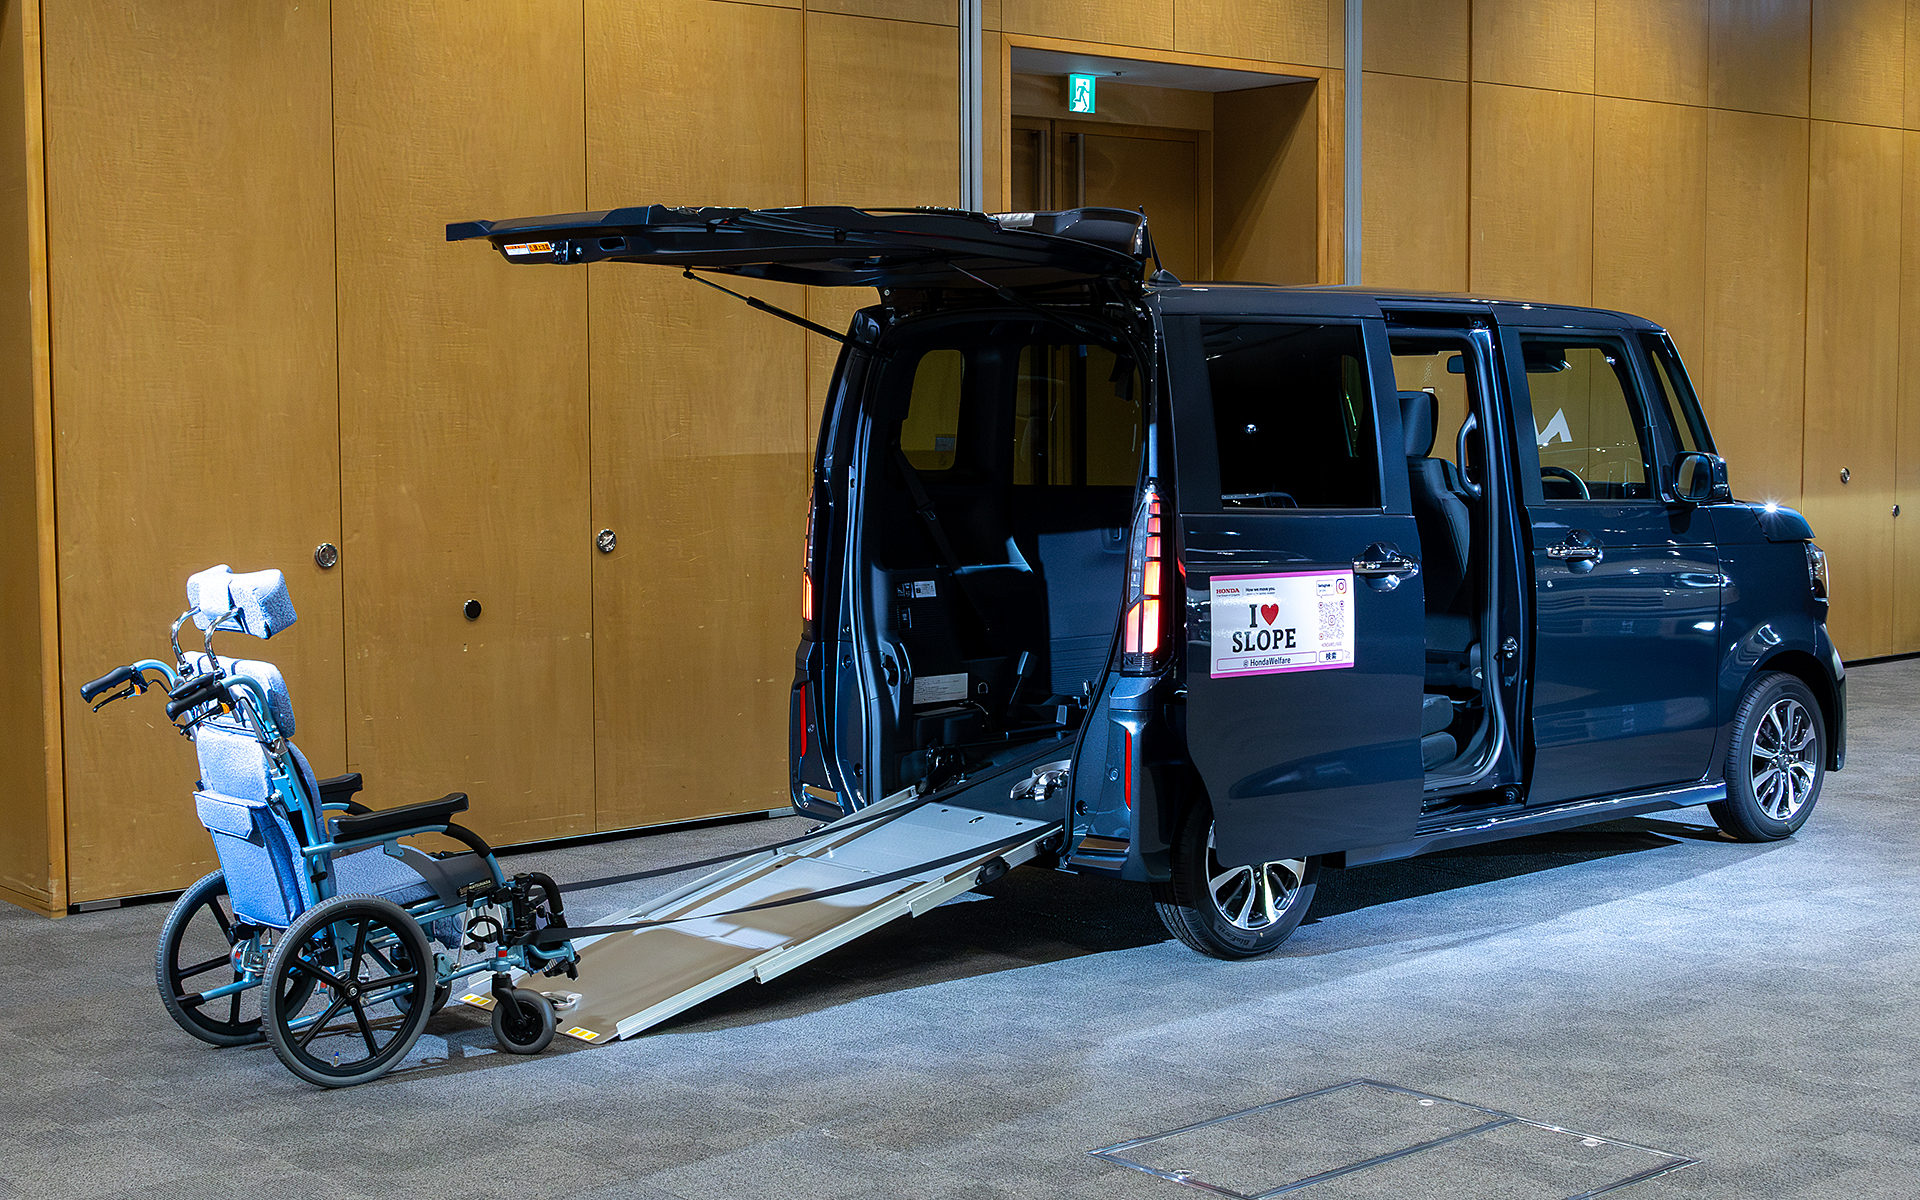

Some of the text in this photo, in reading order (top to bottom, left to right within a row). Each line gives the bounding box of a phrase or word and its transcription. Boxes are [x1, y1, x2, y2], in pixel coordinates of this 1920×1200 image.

[1249, 604, 1258, 628] I
[1232, 628, 1296, 653] SLOPE
[1325, 652, 1337, 660] 検索
